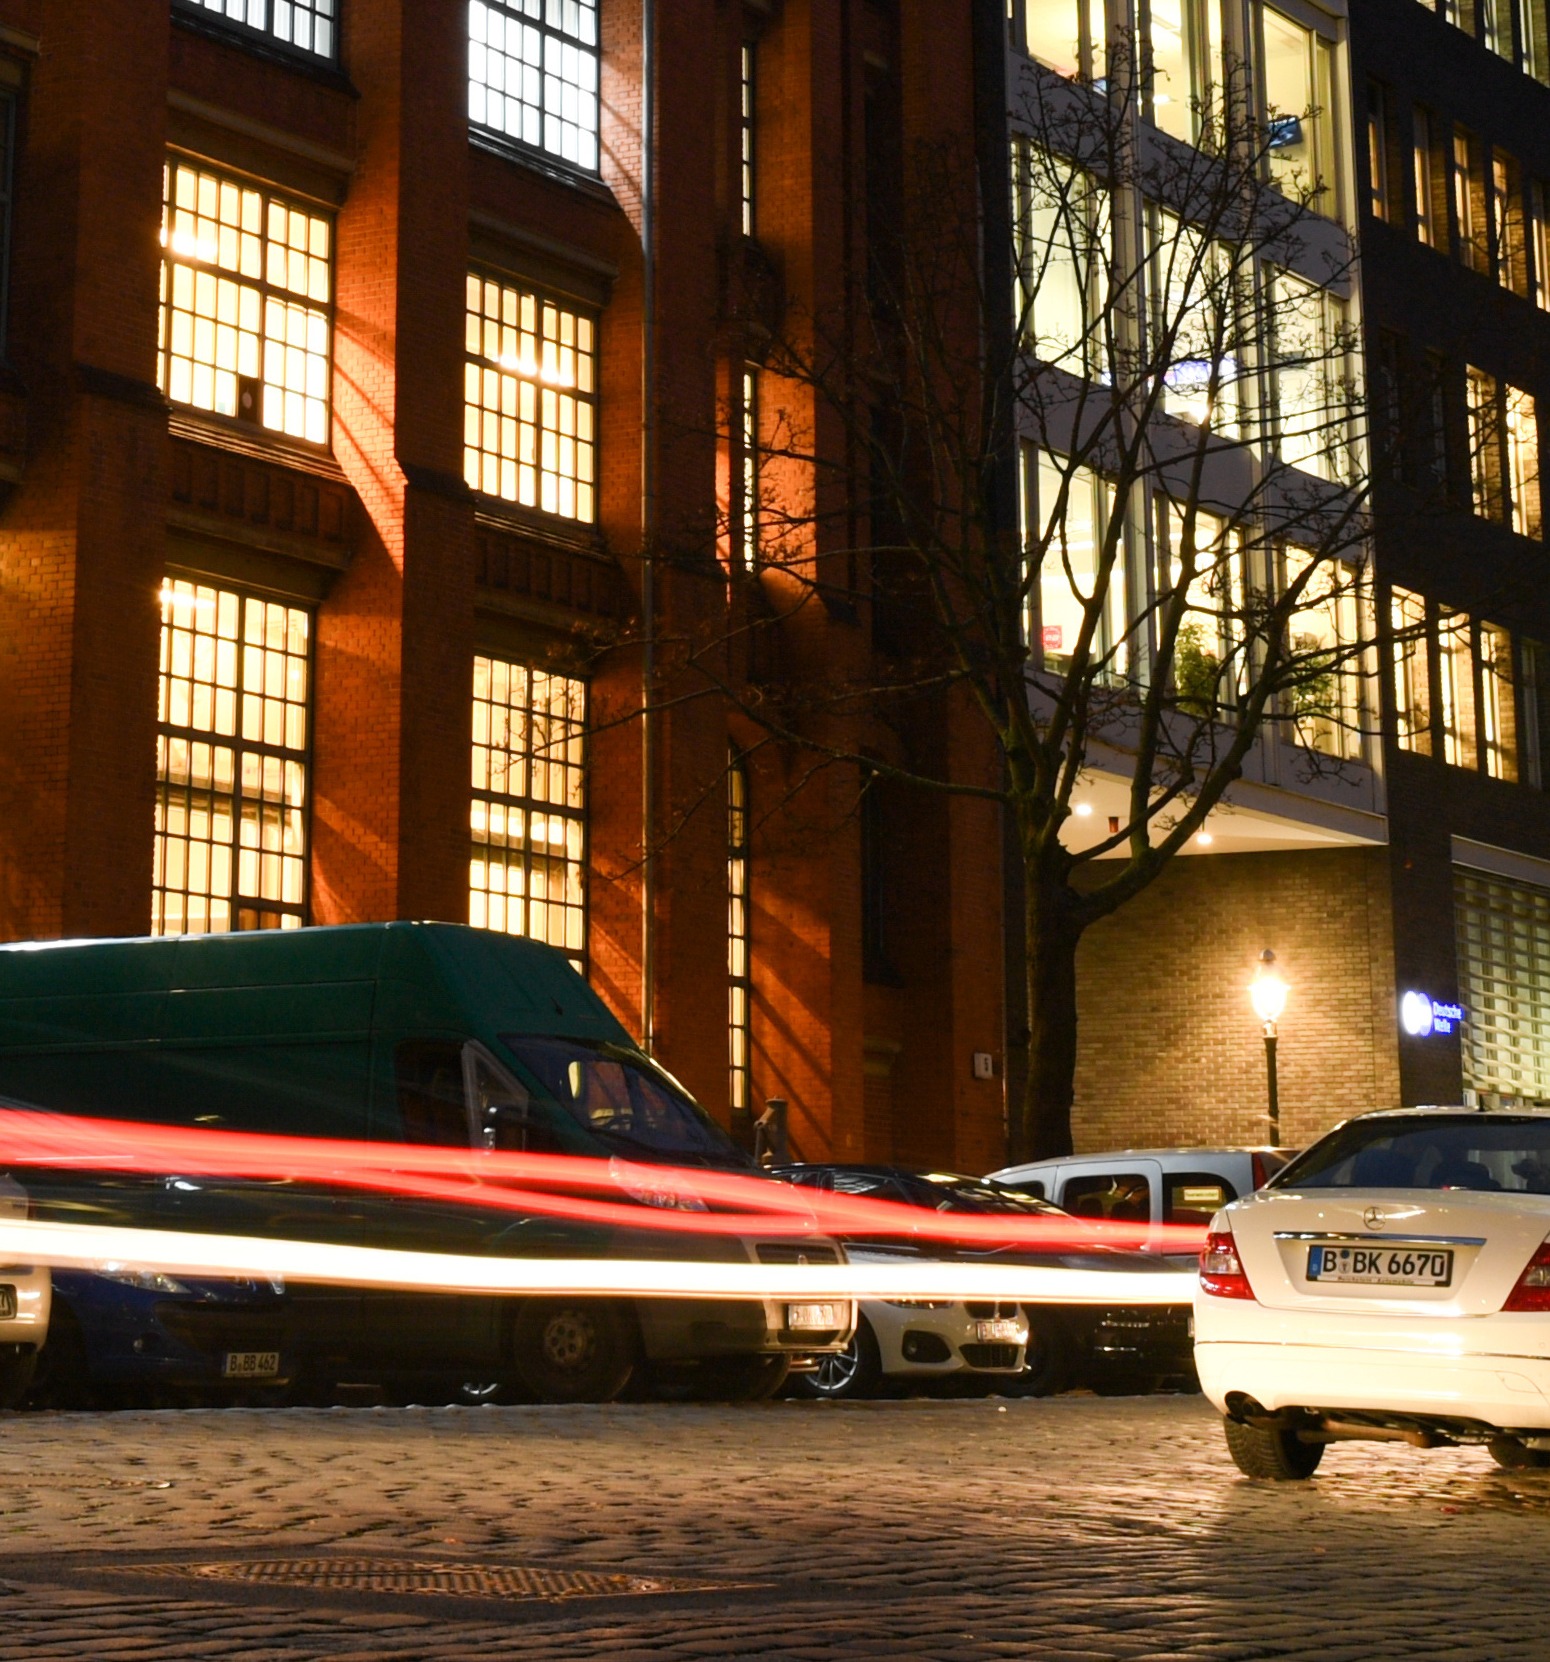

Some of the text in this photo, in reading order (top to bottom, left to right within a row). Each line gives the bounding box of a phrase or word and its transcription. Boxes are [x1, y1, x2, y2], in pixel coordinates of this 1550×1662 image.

[1322, 1250, 1337, 1273] B
[1352, 1251, 1383, 1274] BK
[1387, 1252, 1445, 1277] 6670
[230, 1354, 237, 1371] B
